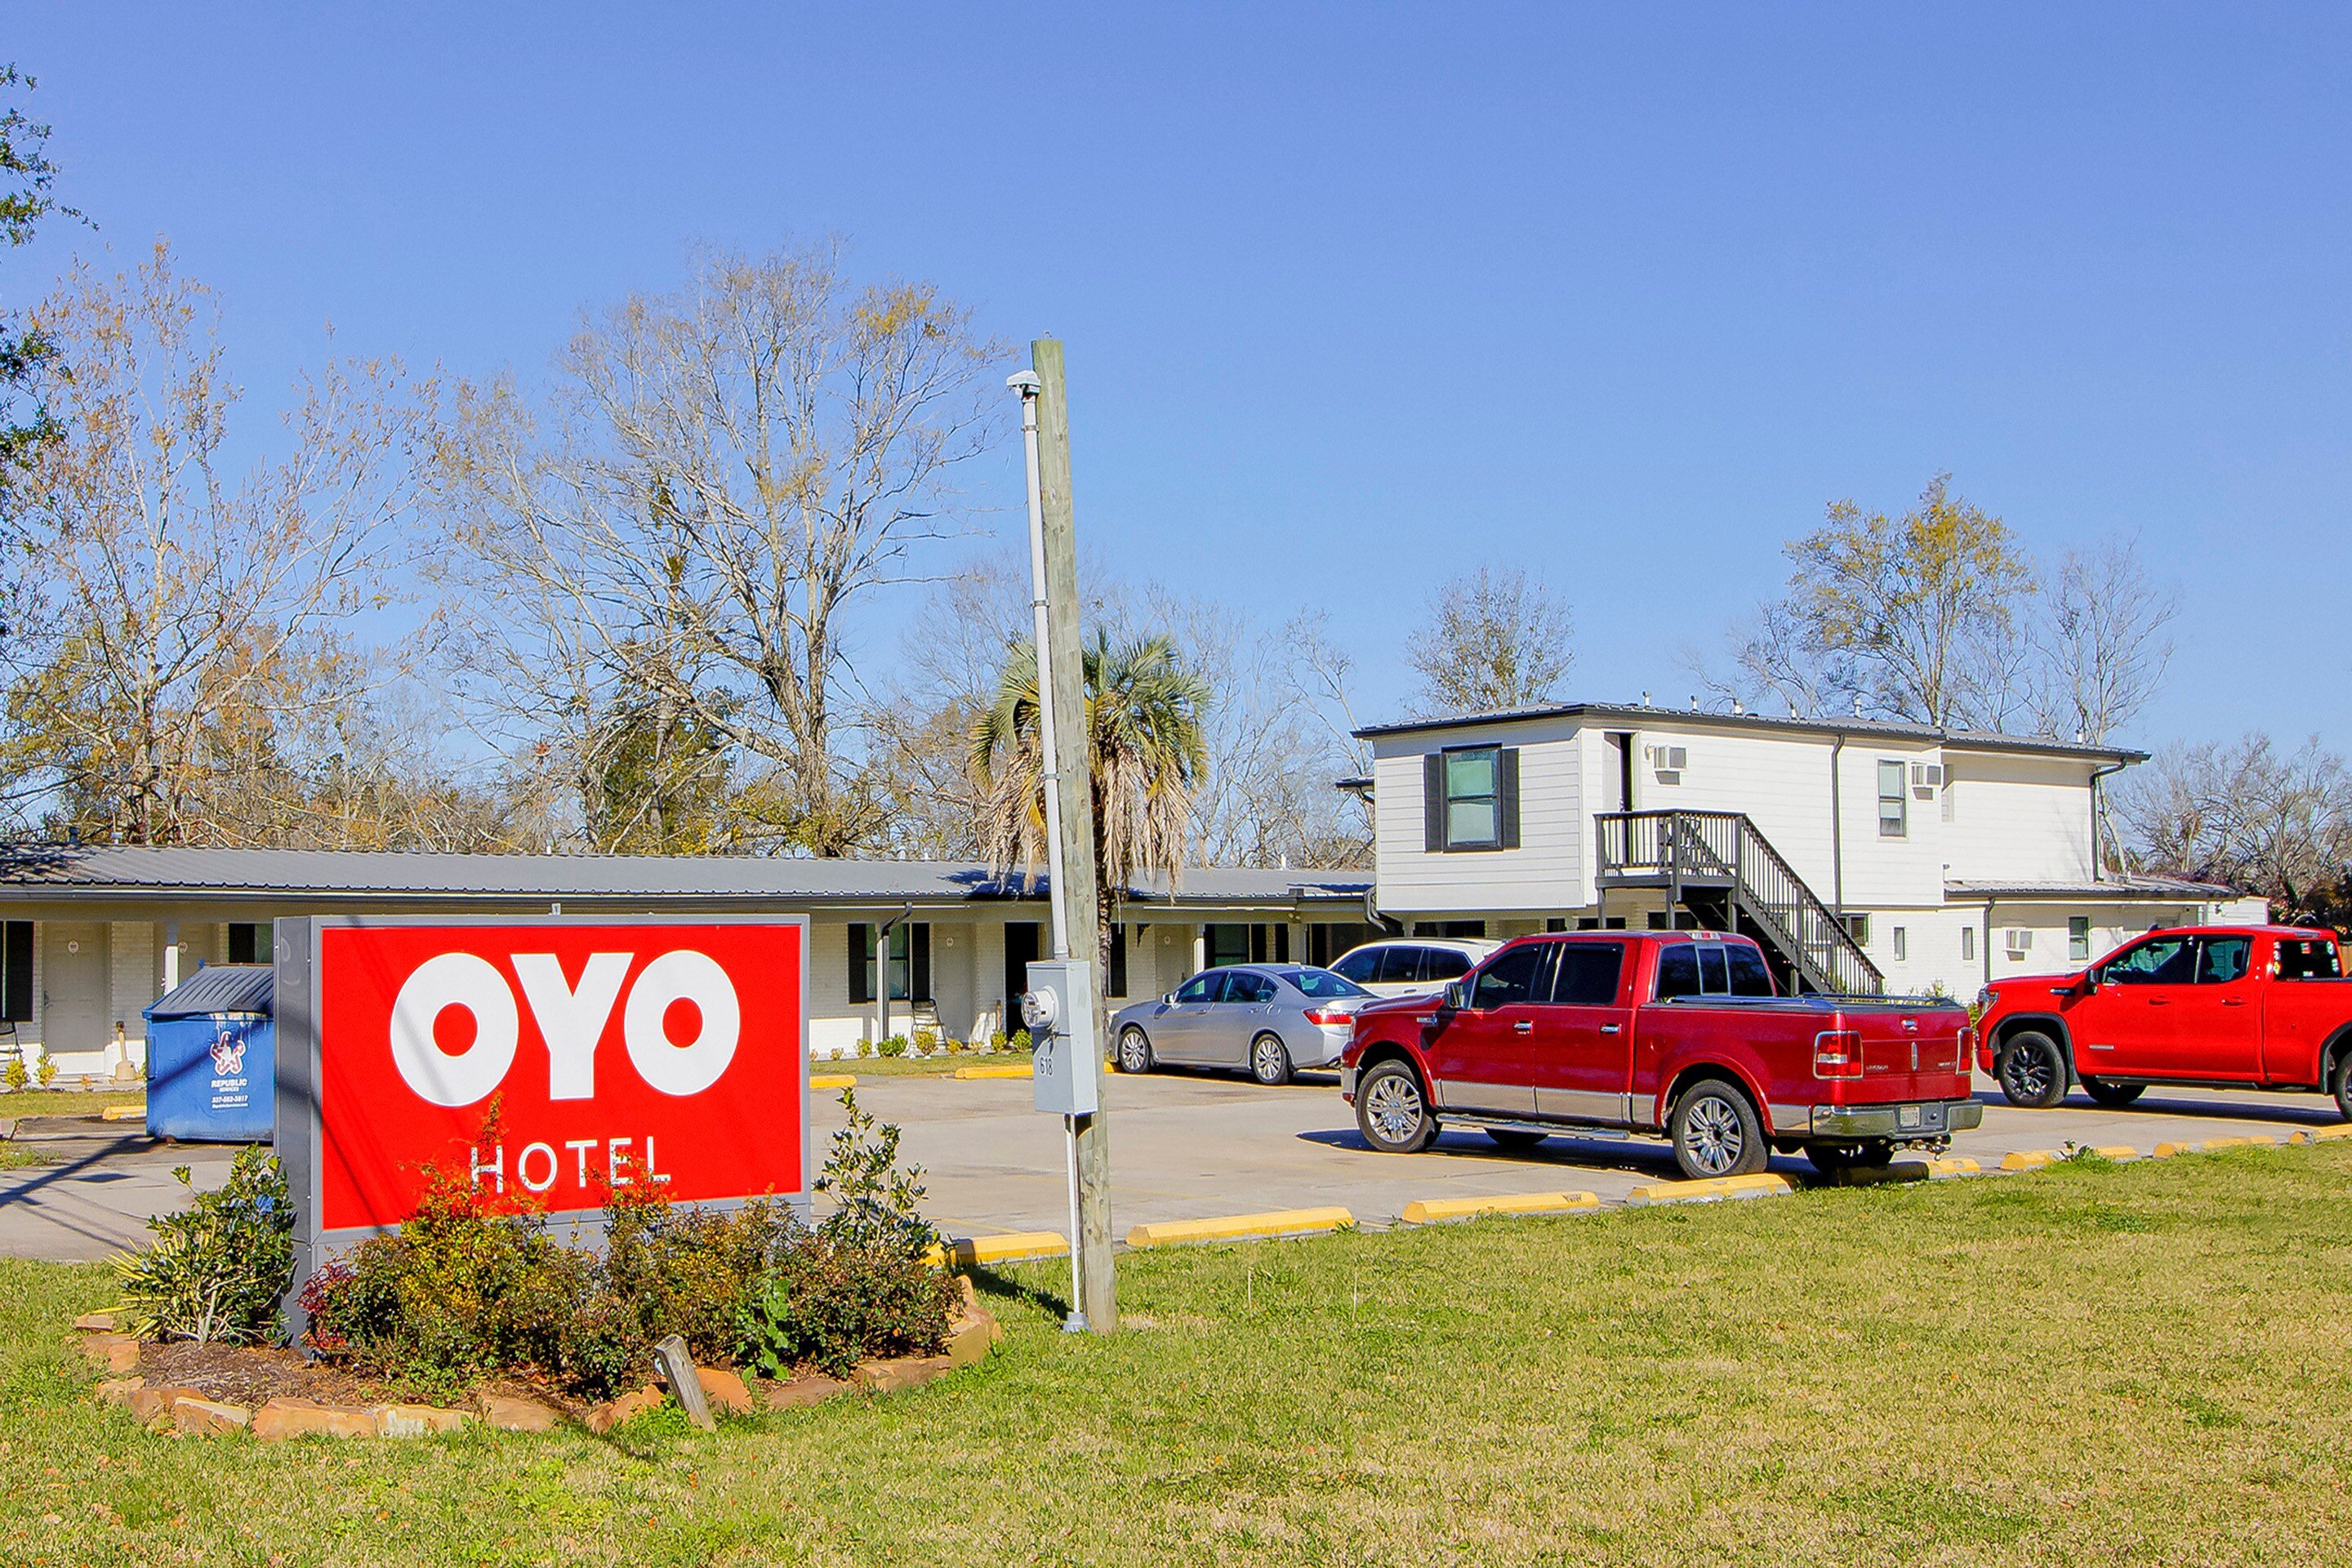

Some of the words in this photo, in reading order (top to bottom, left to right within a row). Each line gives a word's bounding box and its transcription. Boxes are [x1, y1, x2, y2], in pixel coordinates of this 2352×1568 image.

[390, 950, 741, 1107] OYO
[212, 1079, 247, 1088] REPUBLIC
[1040, 1057, 1054, 1076] 618
[470, 1136, 670, 1194] HOTEL
